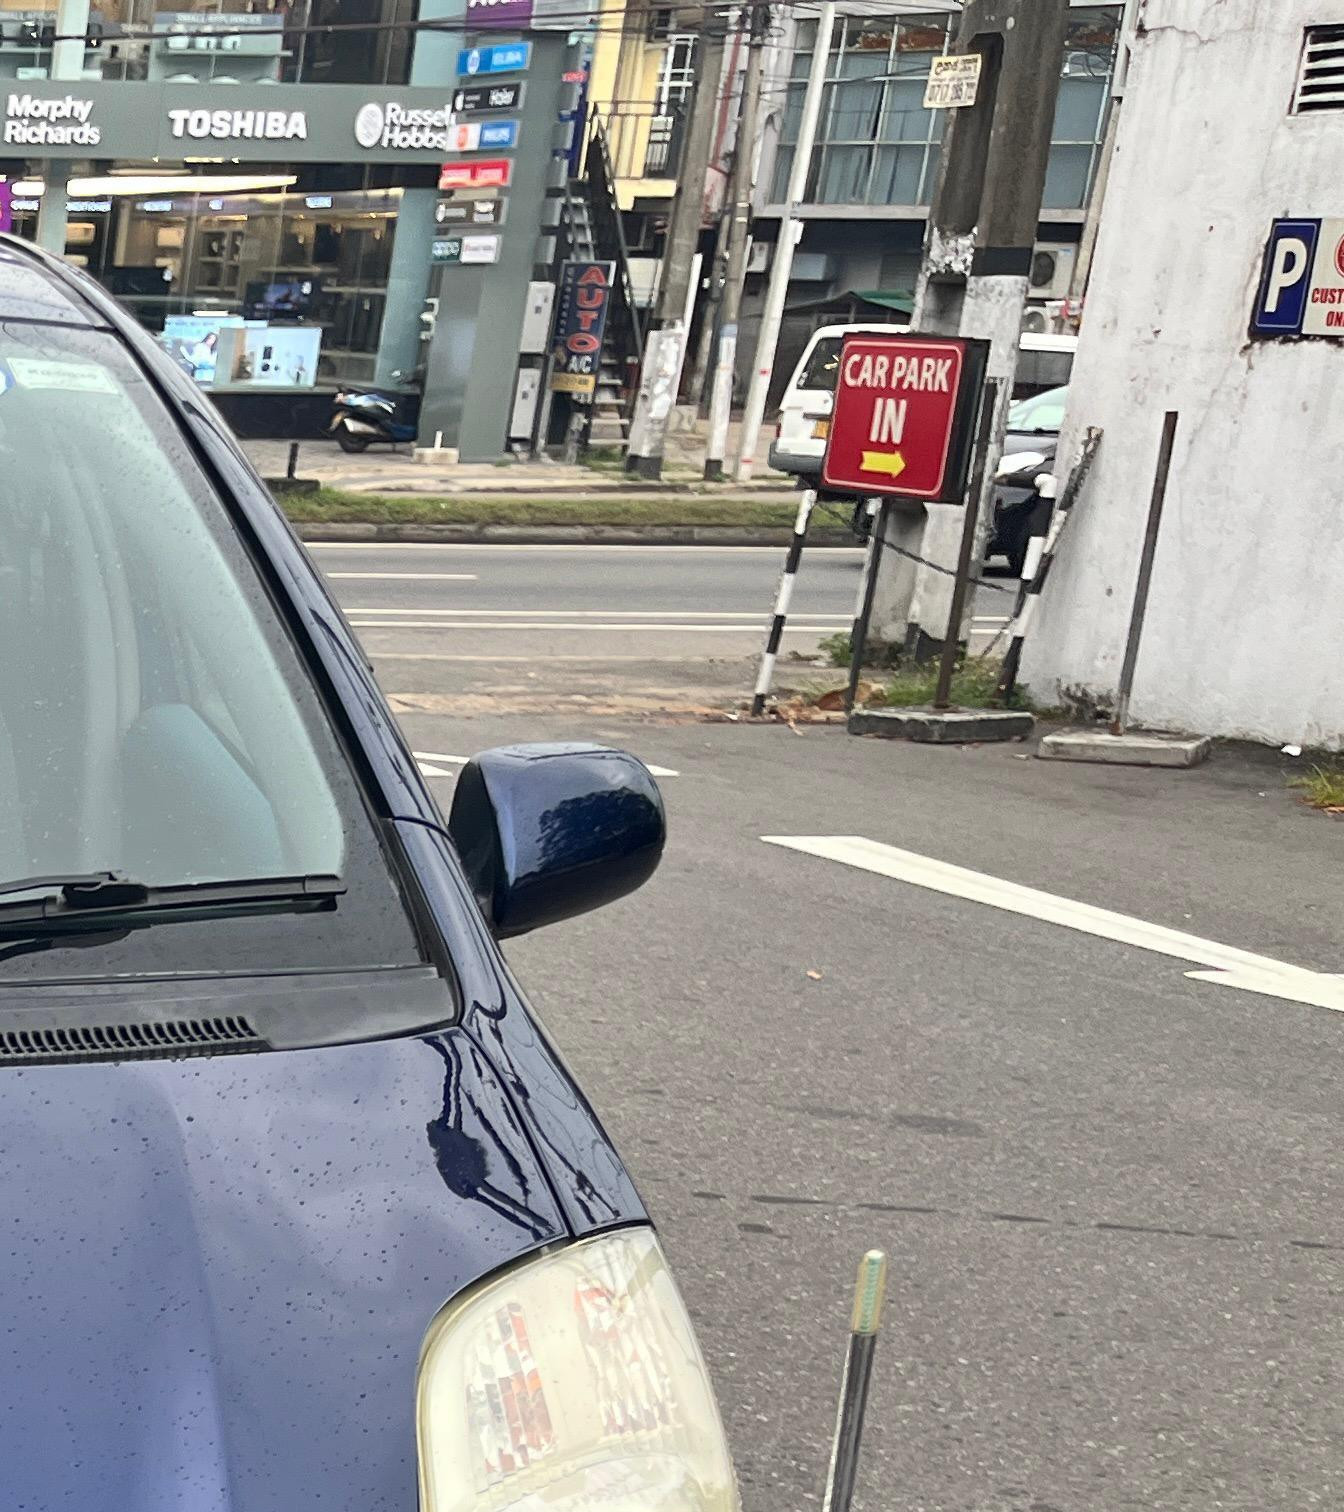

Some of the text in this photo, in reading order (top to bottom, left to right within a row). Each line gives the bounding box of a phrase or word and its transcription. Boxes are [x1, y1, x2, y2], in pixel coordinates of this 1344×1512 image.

[6, 94, 94, 124] Morphy
[168, 109, 308, 140] TOSHIBA
[3, 119, 101, 145] Richards
[1265, 238, 1308, 313] P
[844, 353, 953, 393] CAR PARK
[869, 396, 908, 446] IN
